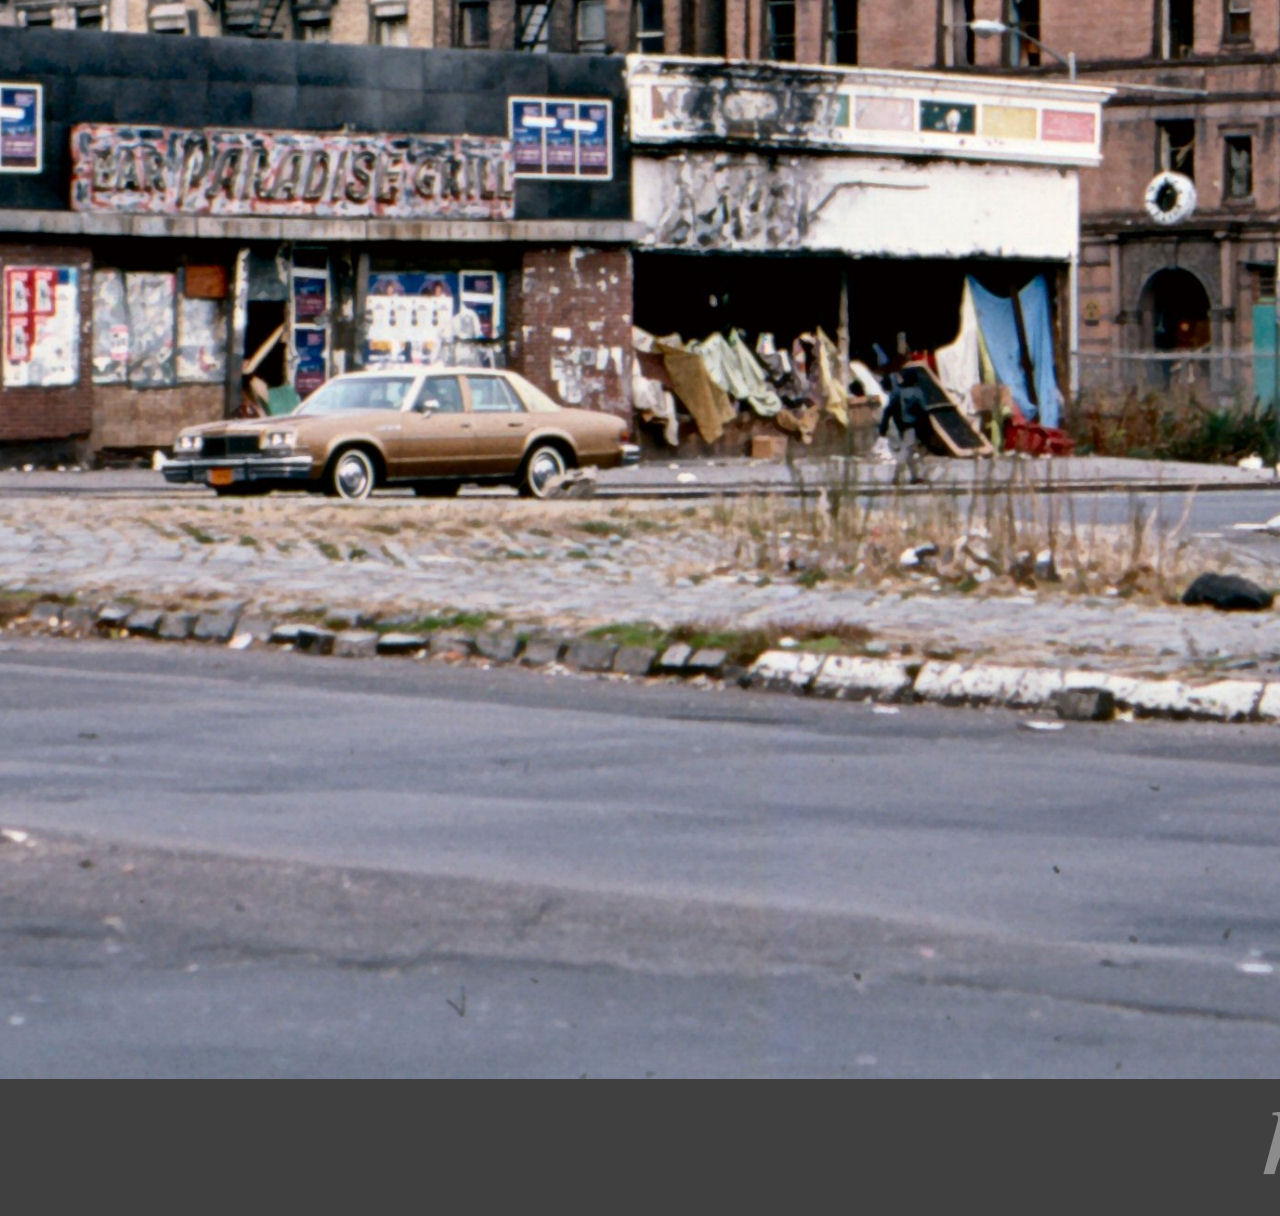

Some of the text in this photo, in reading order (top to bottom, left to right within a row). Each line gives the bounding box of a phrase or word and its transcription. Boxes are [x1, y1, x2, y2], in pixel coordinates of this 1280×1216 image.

[90, 129, 515, 209] BAR PARADISE GRILL
